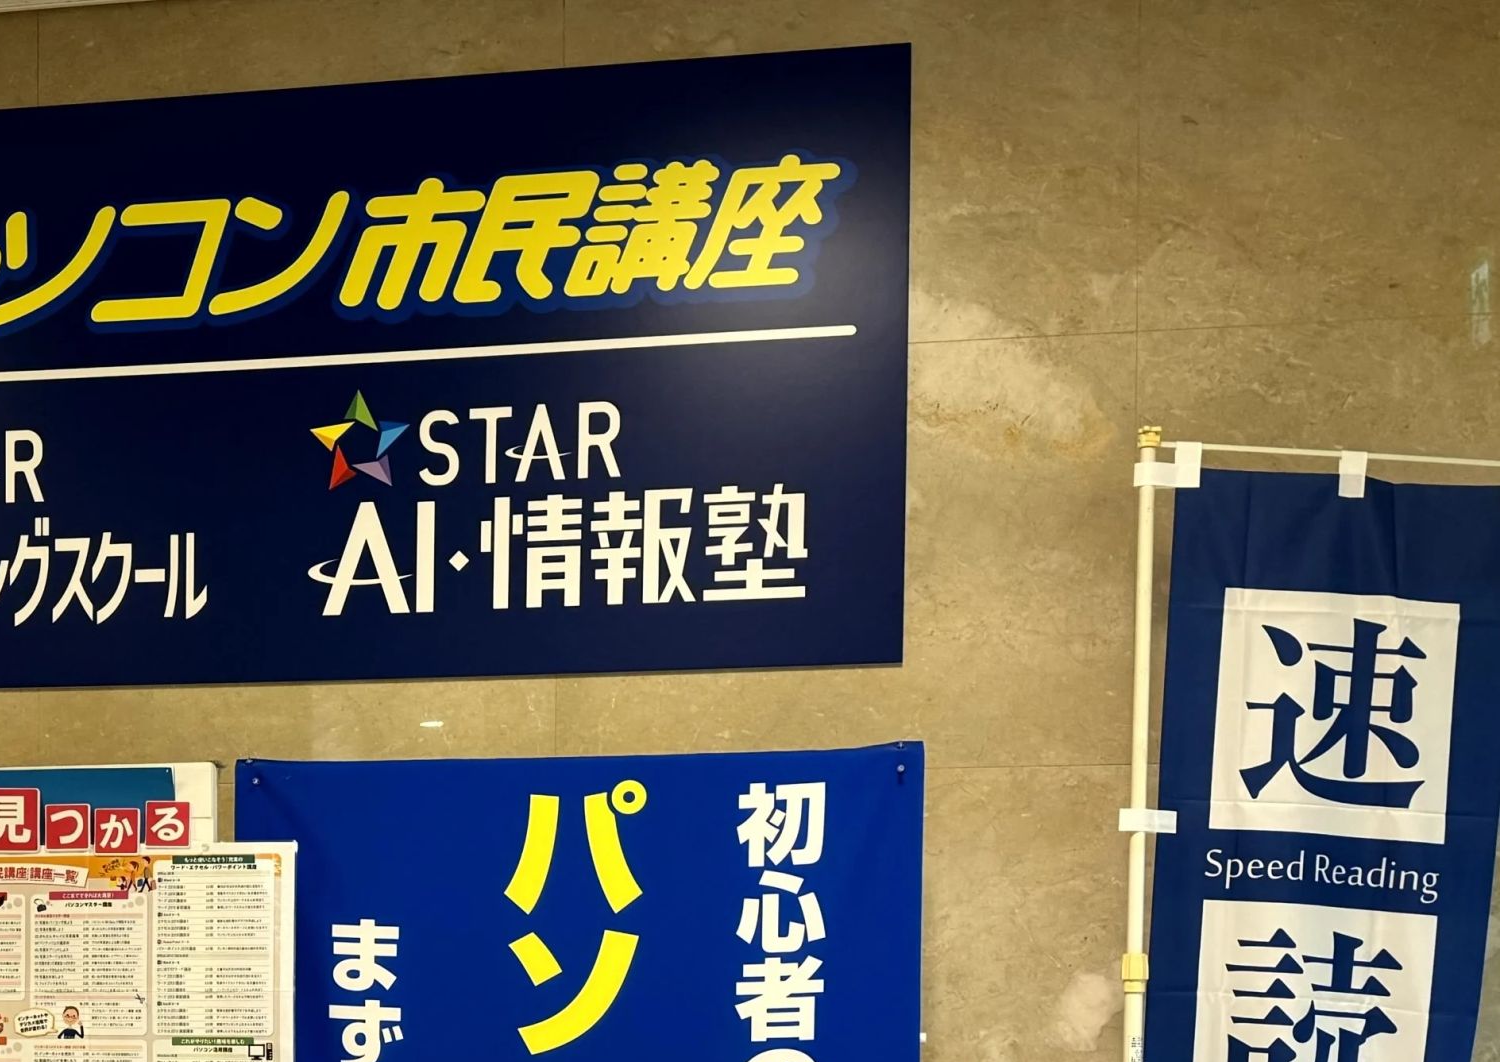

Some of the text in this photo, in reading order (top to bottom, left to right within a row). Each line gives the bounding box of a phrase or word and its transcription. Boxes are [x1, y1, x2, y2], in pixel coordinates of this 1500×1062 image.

[418, 400, 622, 486] STAR
[308, 482, 809, 619] AI・情報塾
[30, 867, 78, 884] 講座一覧
[1204, 847, 1440, 904] Speed Reading
